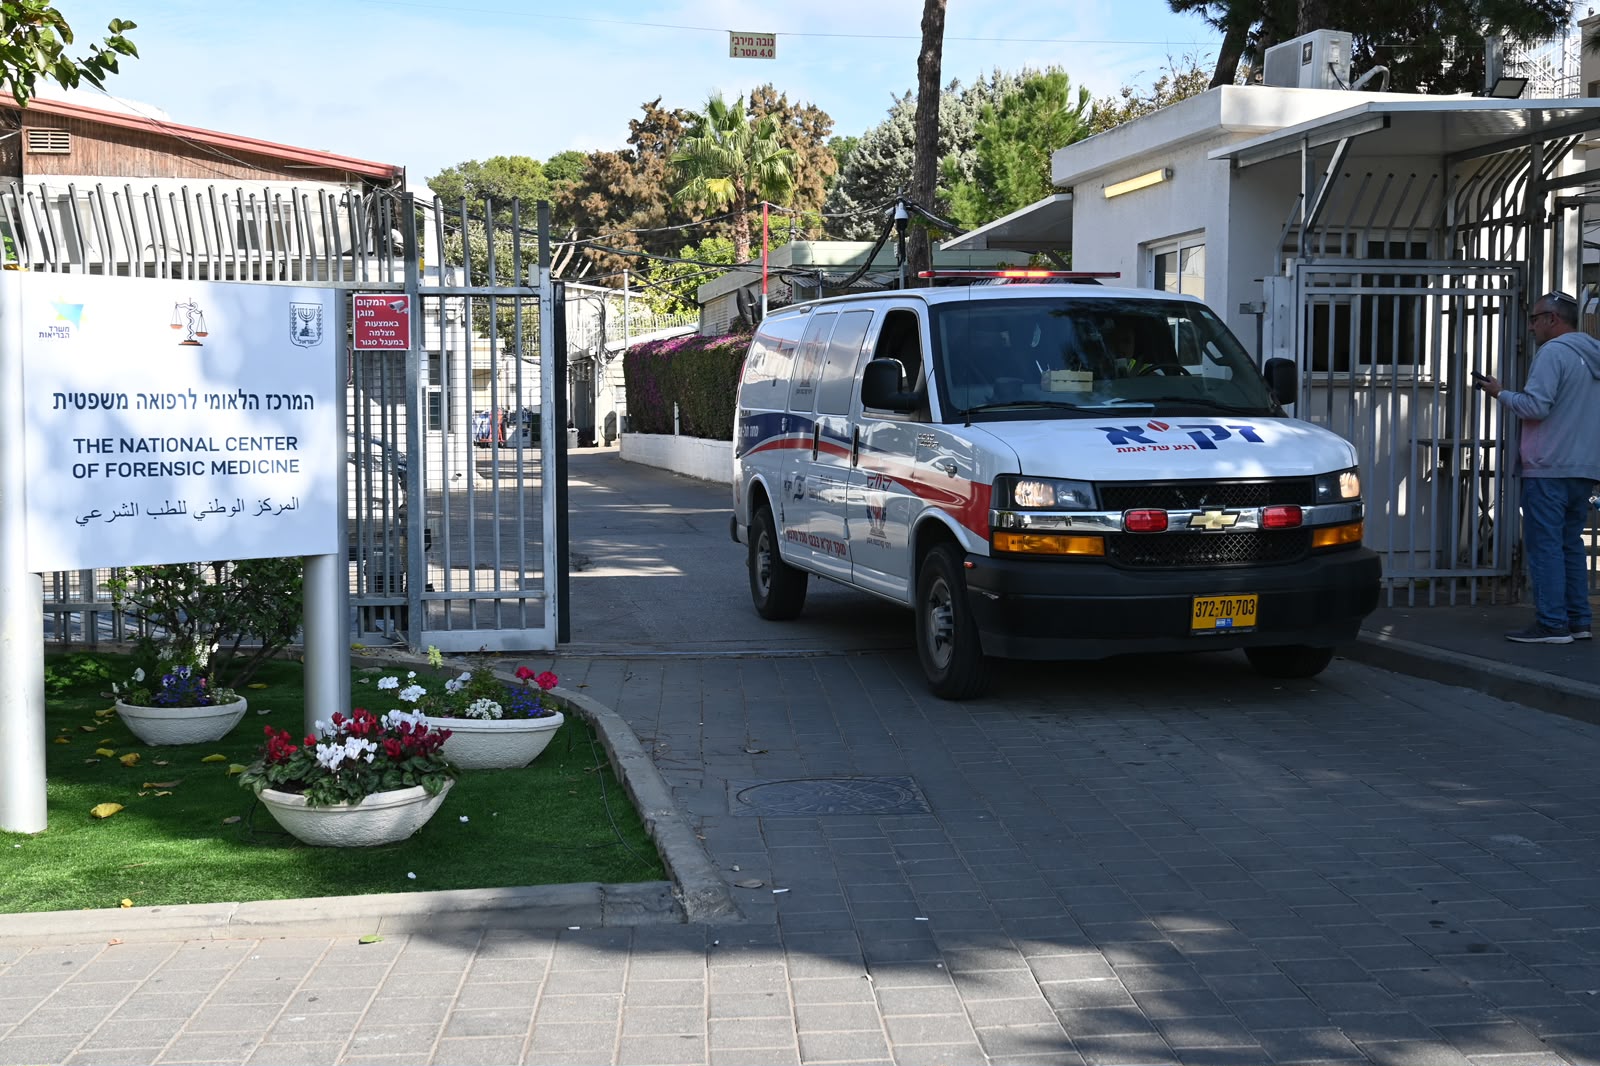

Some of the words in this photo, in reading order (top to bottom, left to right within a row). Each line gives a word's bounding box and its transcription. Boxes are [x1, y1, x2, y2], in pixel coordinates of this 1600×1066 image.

[732, 37, 753, 46] מירבי
[740, 48, 758, 56] מטר
[760, 48, 773, 57] 4.0
[357, 300, 386, 308] המקום
[357, 309, 375, 318] מוגן
[52, 391, 129, 411] משפטית
[136, 388, 198, 411] לרפואה
[204, 388, 260, 411] הלאומי
[266, 393, 314, 411] המרכז
[73, 438, 114, 454] THE
[120, 436, 220, 454] NATIONAL
[225, 436, 298, 452] CENTER
[1116, 445, 1147, 453] אמת
[1148, 444, 1170, 452] של
[72, 463, 99, 479] OF
[105, 461, 205, 478] FORENSIC
[211, 459, 300, 476] MEDICINE
[75, 502, 140, 527] الشرعي
[146, 500, 188, 520] للطب
[193, 498, 245, 522] الوطني
[252, 496, 300, 517] المركز
